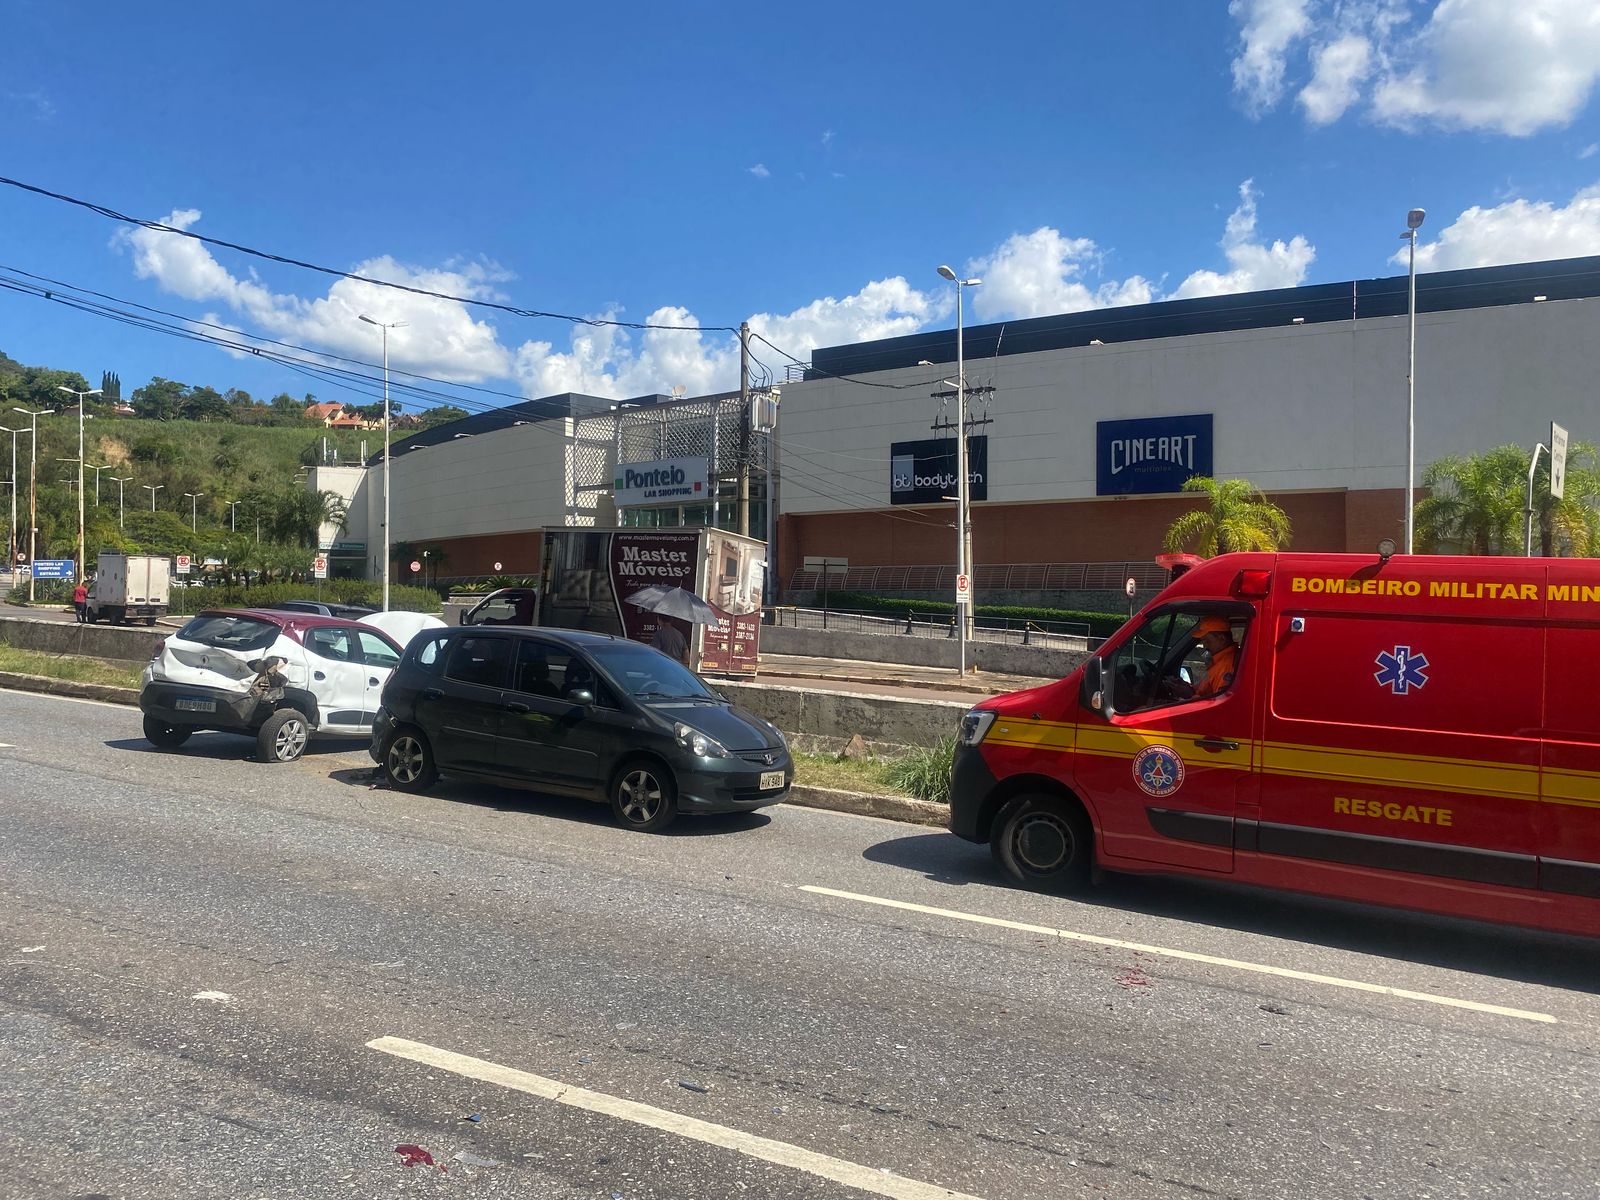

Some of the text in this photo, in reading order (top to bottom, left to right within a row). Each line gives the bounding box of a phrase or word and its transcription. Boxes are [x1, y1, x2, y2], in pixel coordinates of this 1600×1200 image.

[1111, 435, 1196, 475] CINEART
[625, 465, 686, 489] Ponteio
[644, 487, 692, 498] LAR SHOPPING
[622, 546, 688, 562] Master
[618, 562, 684, 577] Móveis
[1292, 577, 1600, 602] BOMBEIRO MILITAR MIN
[1147, 748, 1177, 759] BOMBEIROS
[1140, 782, 1176, 795] MINAS GERAIS
[1334, 797, 1453, 826] RESGATE
